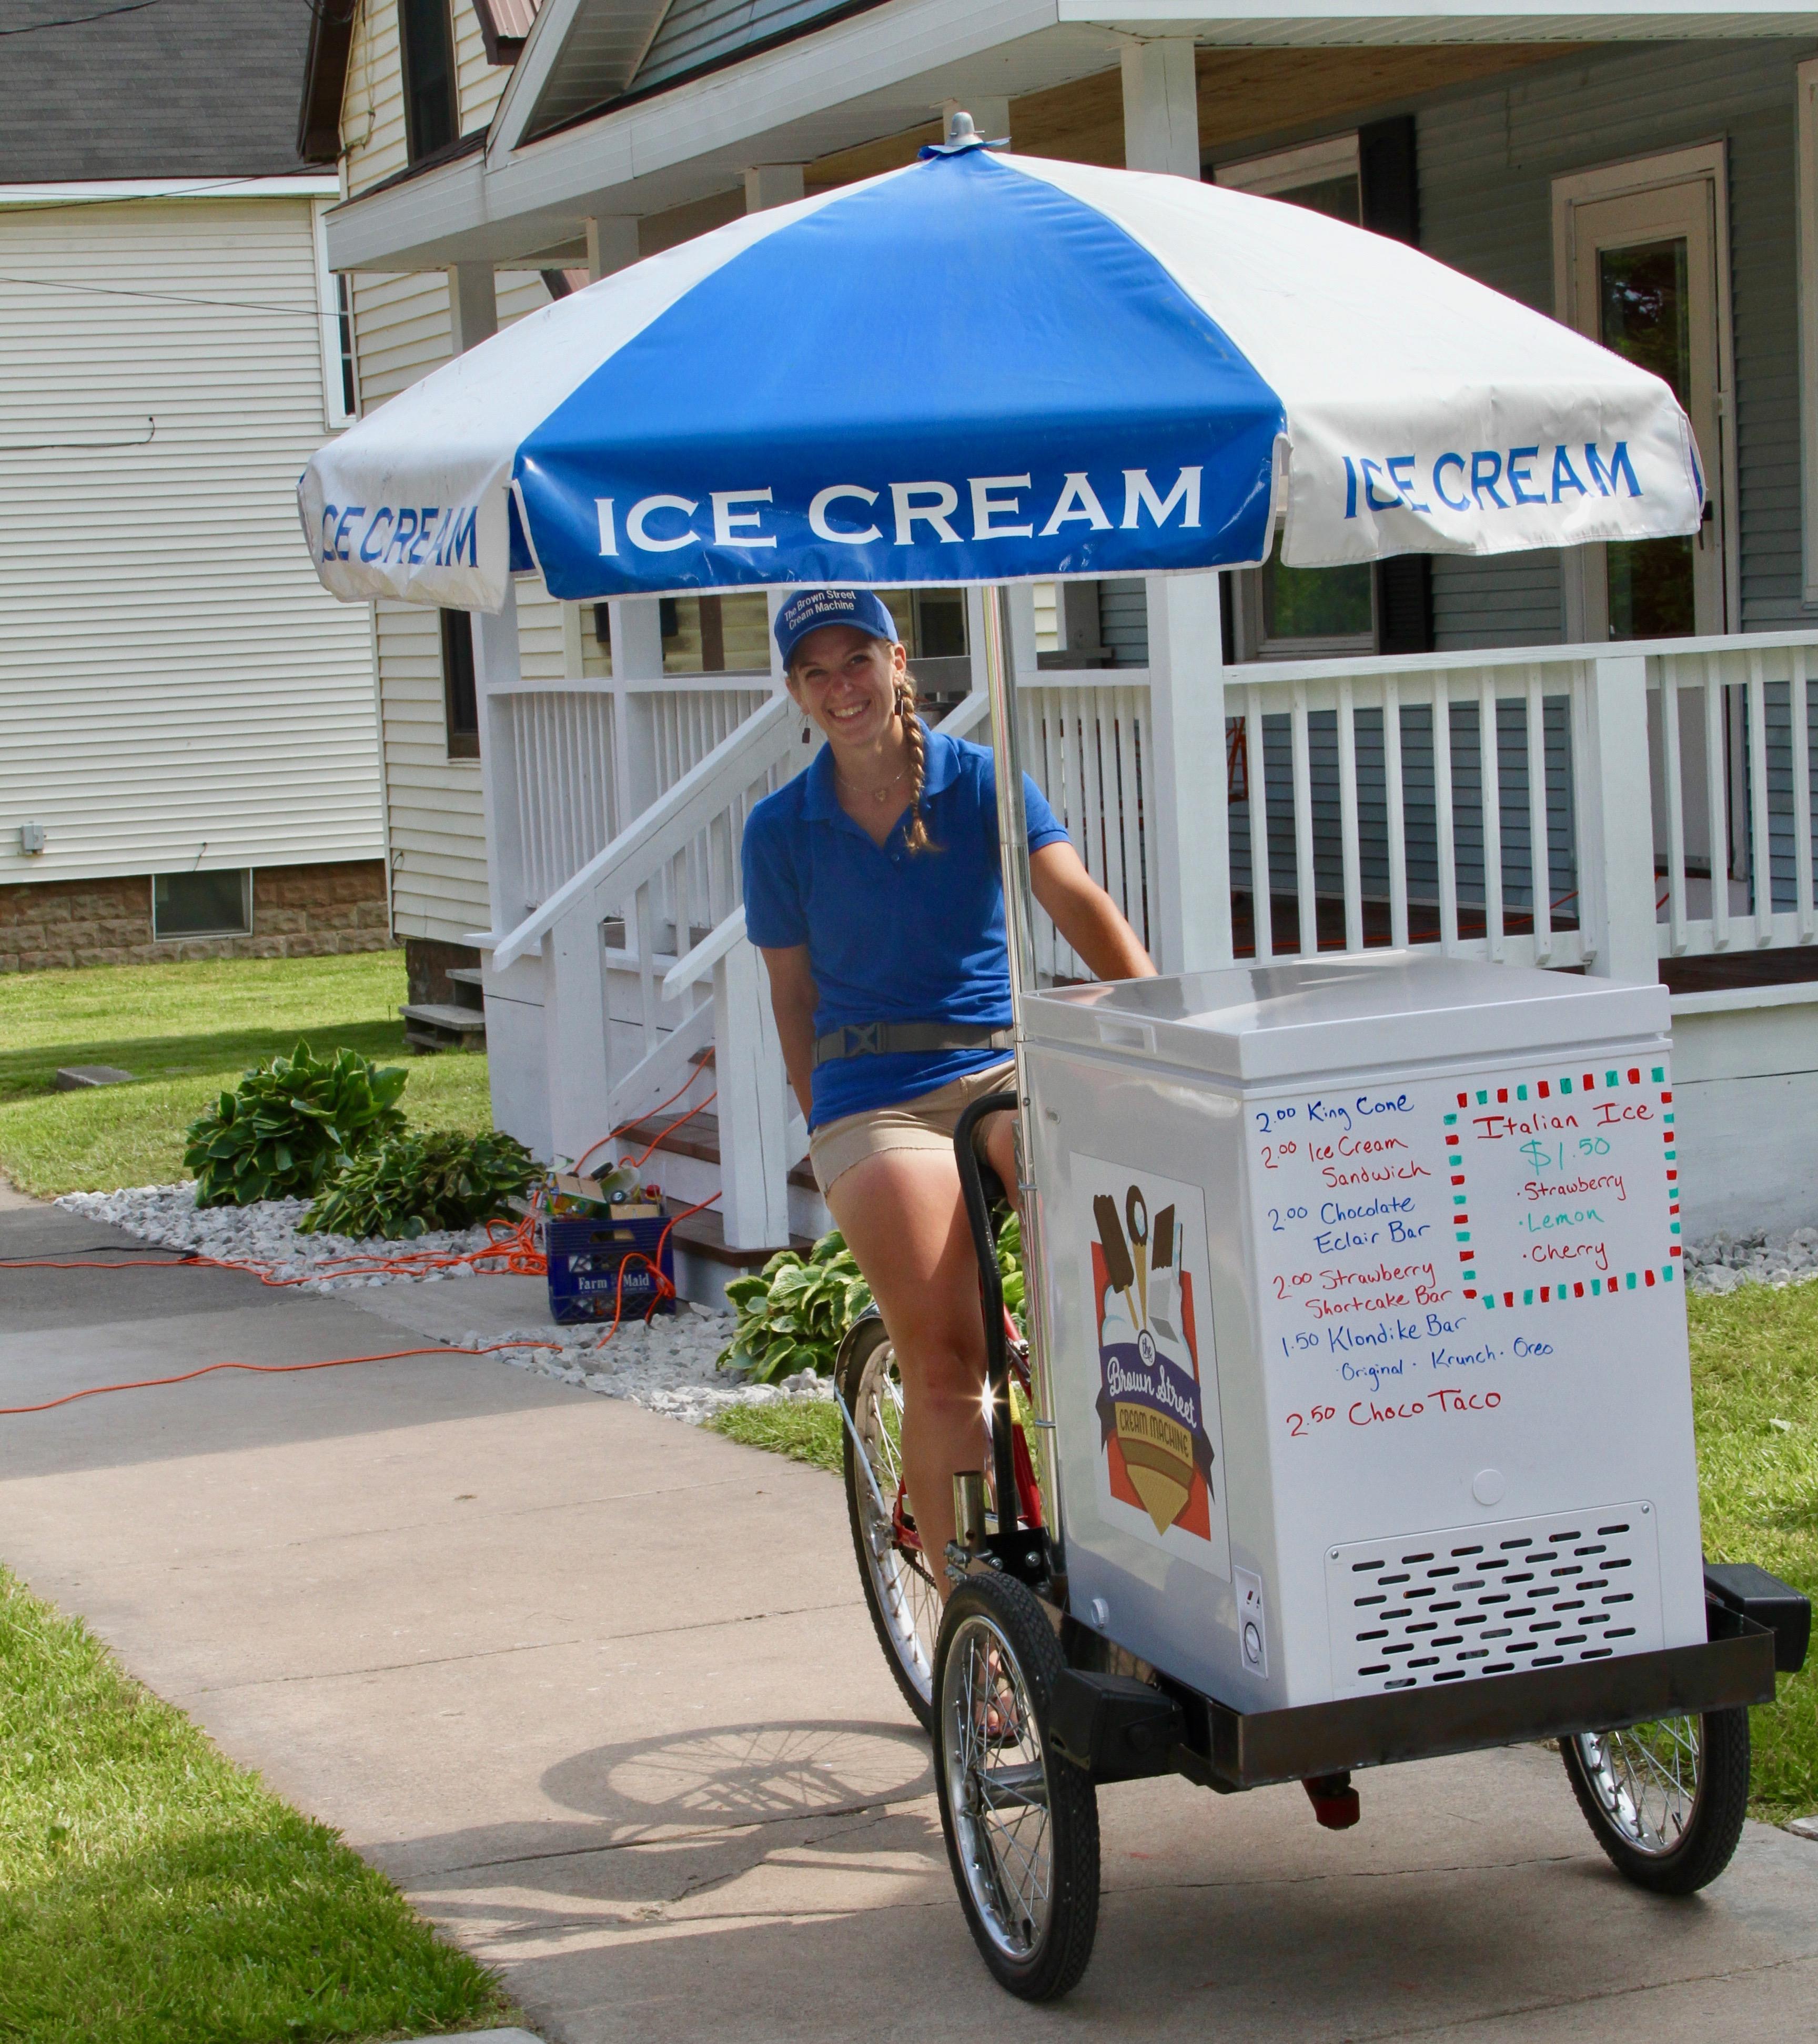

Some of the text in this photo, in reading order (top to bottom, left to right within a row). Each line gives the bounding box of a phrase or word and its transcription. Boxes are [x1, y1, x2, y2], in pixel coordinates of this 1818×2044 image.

[1342, 441, 1644, 519] ICE CREAM
[594, 466, 1204, 556] ICE CREAM
[322, 504, 479, 568] CE CREAM
[784, 590, 856, 621] The Brown Street
[789, 600, 854, 630] Cream Machine
[1256, 1095, 1414, 1132] 2.00 King Cone
[1472, 1102, 1654, 1139] Italian Ice
[1261, 1136, 1408, 1168] 2.00 Ice Cream
[1520, 1137, 1610, 1175] $1.50
[1322, 1160, 1431, 1187] Sandwich
[1268, 1196, 1415, 1231] 2.00 Chocolate
[1528, 1209, 1604, 1232] Lemon
[1313, 1220, 1430, 1253] Eclair Bar
[1532, 1242, 1608, 1270] Cherry
[579, 1273, 650, 1289] Farm Maid
[1273, 1262, 1436, 1299] 2.00 Strawberry
[1305, 1285, 1452, 1319] Shortcake Bar
[1142, 1338, 1153, 1362] the
[1281, 1313, 1467, 1357] 1.50 Klondike Bar
[1342, 1337, 1553, 1391] Original Krunch Oreo
[1107, 1357, 1197, 1429] Brown Street
[1286, 1389, 1501, 1436] 2.50 Choco Taco
[1119, 1410, 1189, 1458] CREAM MACHINE
